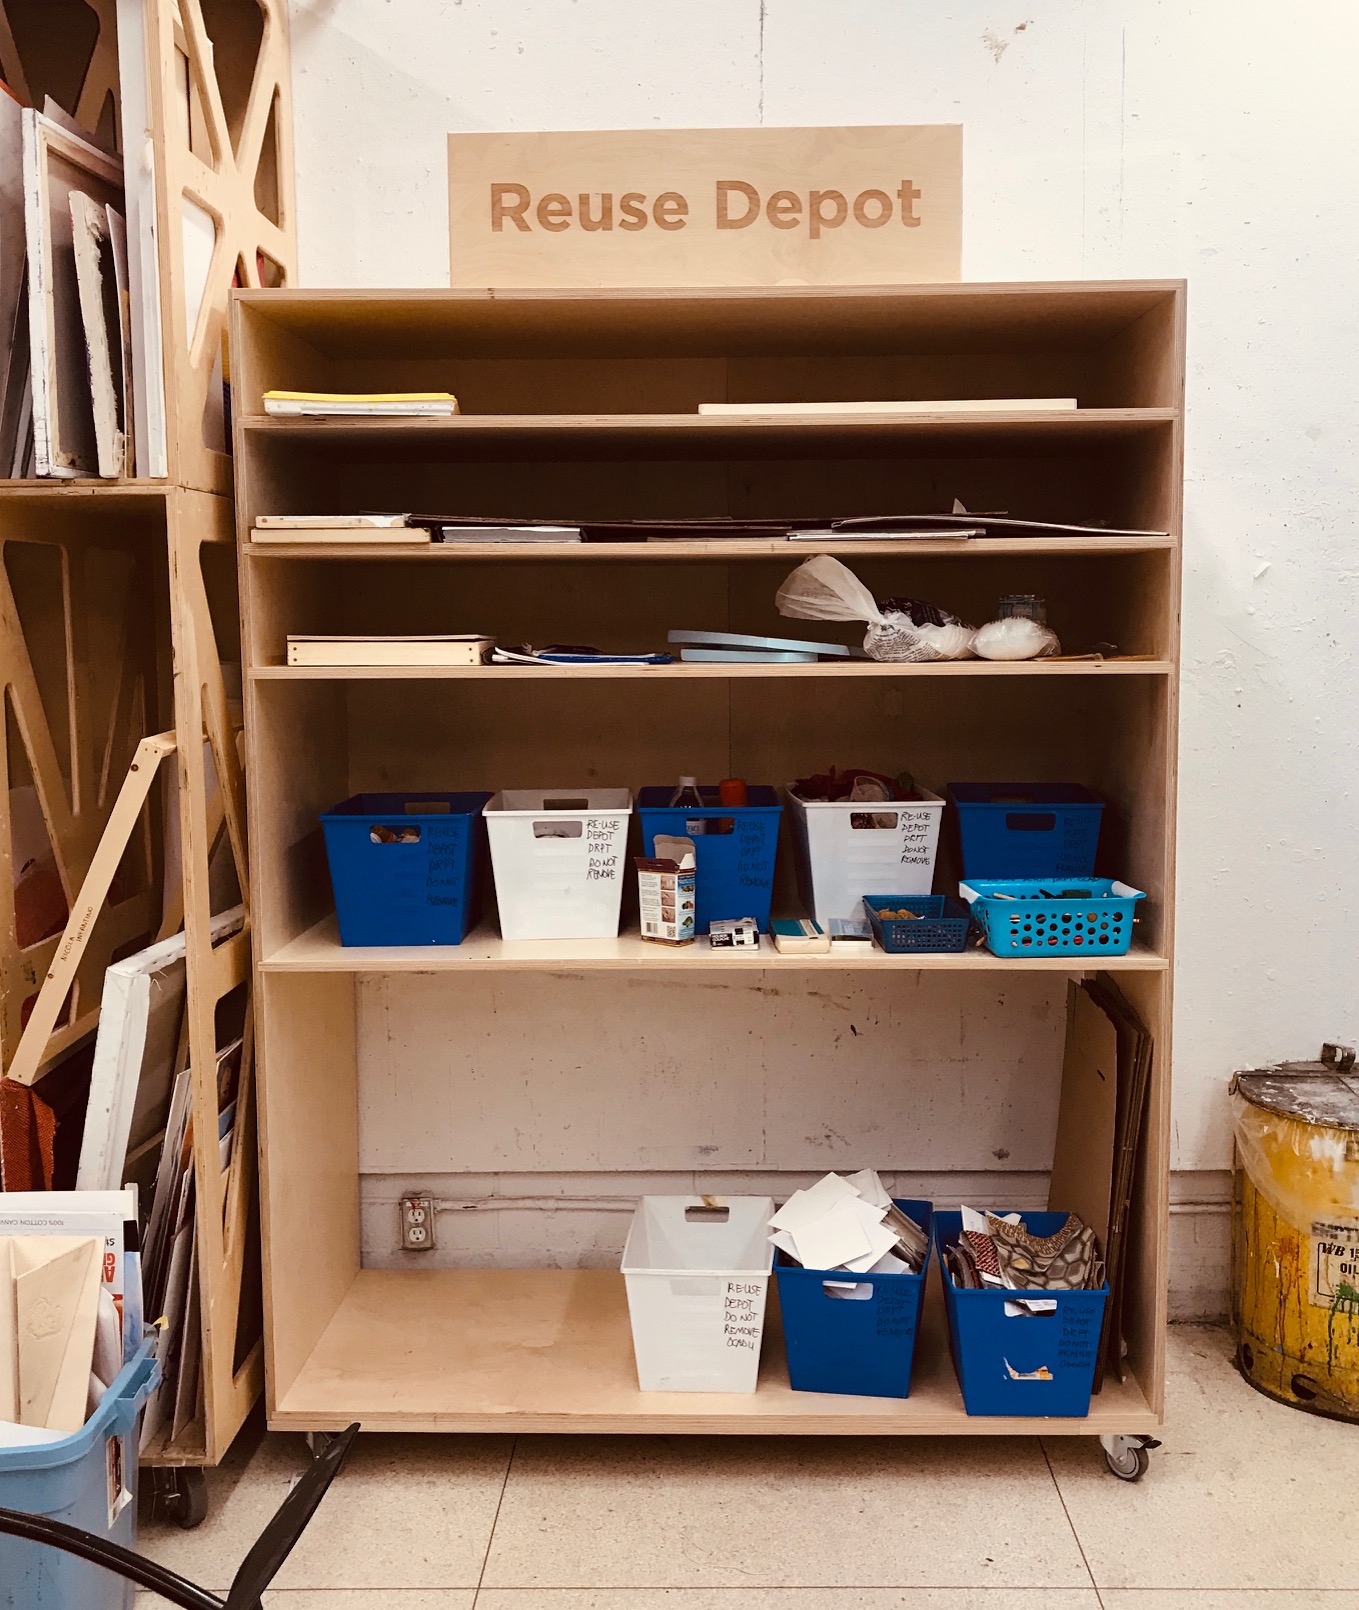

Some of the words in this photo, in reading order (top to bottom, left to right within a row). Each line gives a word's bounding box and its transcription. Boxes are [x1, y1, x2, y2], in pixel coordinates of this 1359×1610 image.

[490, 182, 689, 232] Reuse
[716, 180, 922, 239] Depot
[587, 820, 620, 831] RE-USE
[902, 824, 930, 832] DEPOT
[587, 830, 615, 841] DEPOT
[589, 858, 601, 867] DO
[603, 856, 618, 867] NOT
[61, 936, 75, 961] NICOLA
[725, 1297, 754, 1311] DEPOT
[724, 1311, 737, 1322] DO
[740, 1312, 758, 1321] NOT
[724, 1324, 760, 1338] REMOVE
